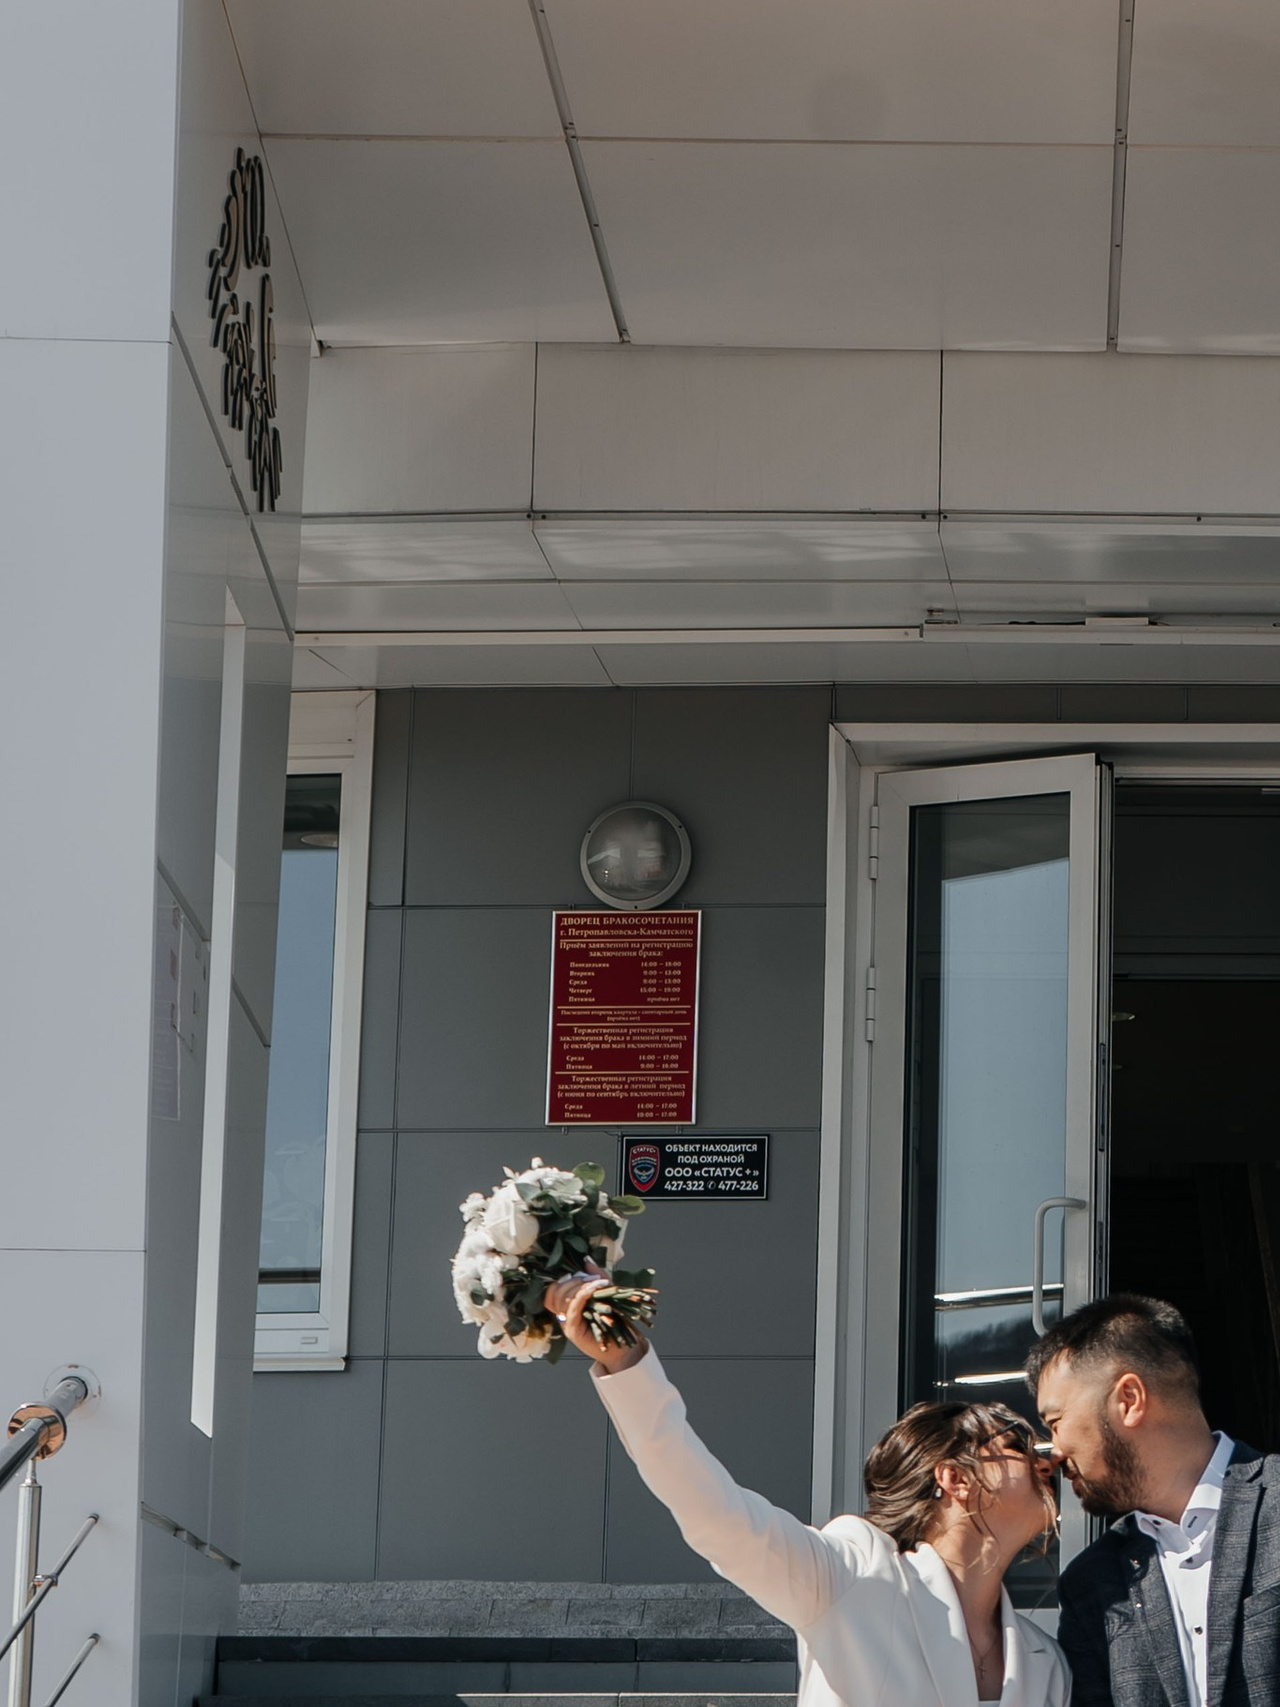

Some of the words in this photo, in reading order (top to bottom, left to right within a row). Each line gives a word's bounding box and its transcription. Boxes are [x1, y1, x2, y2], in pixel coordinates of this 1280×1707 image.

[560, 917, 601, 926] ДВОРЕЦ
[603, 917, 694, 925] БРАКОСОЧЕТАНИЯ
[568, 928, 694, 938] Петропавловска-Камчатского
[560, 942, 586, 950] Приём
[641, 942, 694, 950] регистрацию
[638, 950, 664, 958] брака:
[569, 987, 593, 995] Четверг
[573, 1027, 627, 1035] Торжественная
[629, 1027, 674, 1035] регистрация
[604, 1034, 625, 1042] брака
[570, 1042, 600, 1050] октября
[572, 1075, 626, 1083] Торжественная
[602, 1083, 623, 1091] брака
[596, 1091, 629, 1099] сентябрь
[665, 1144, 701, 1152] ОБЪЕКТ
[702, 1144, 758, 1153] НАХОДИТСЯ
[677, 1155, 699, 1164] ПОД
[699, 1154, 745, 1164] ОХРАНОЙ
[664, 1167, 692, 1177] ООО
[664, 1181, 705, 1191] 427-322
[717, 1180, 759, 1190] 477-226
